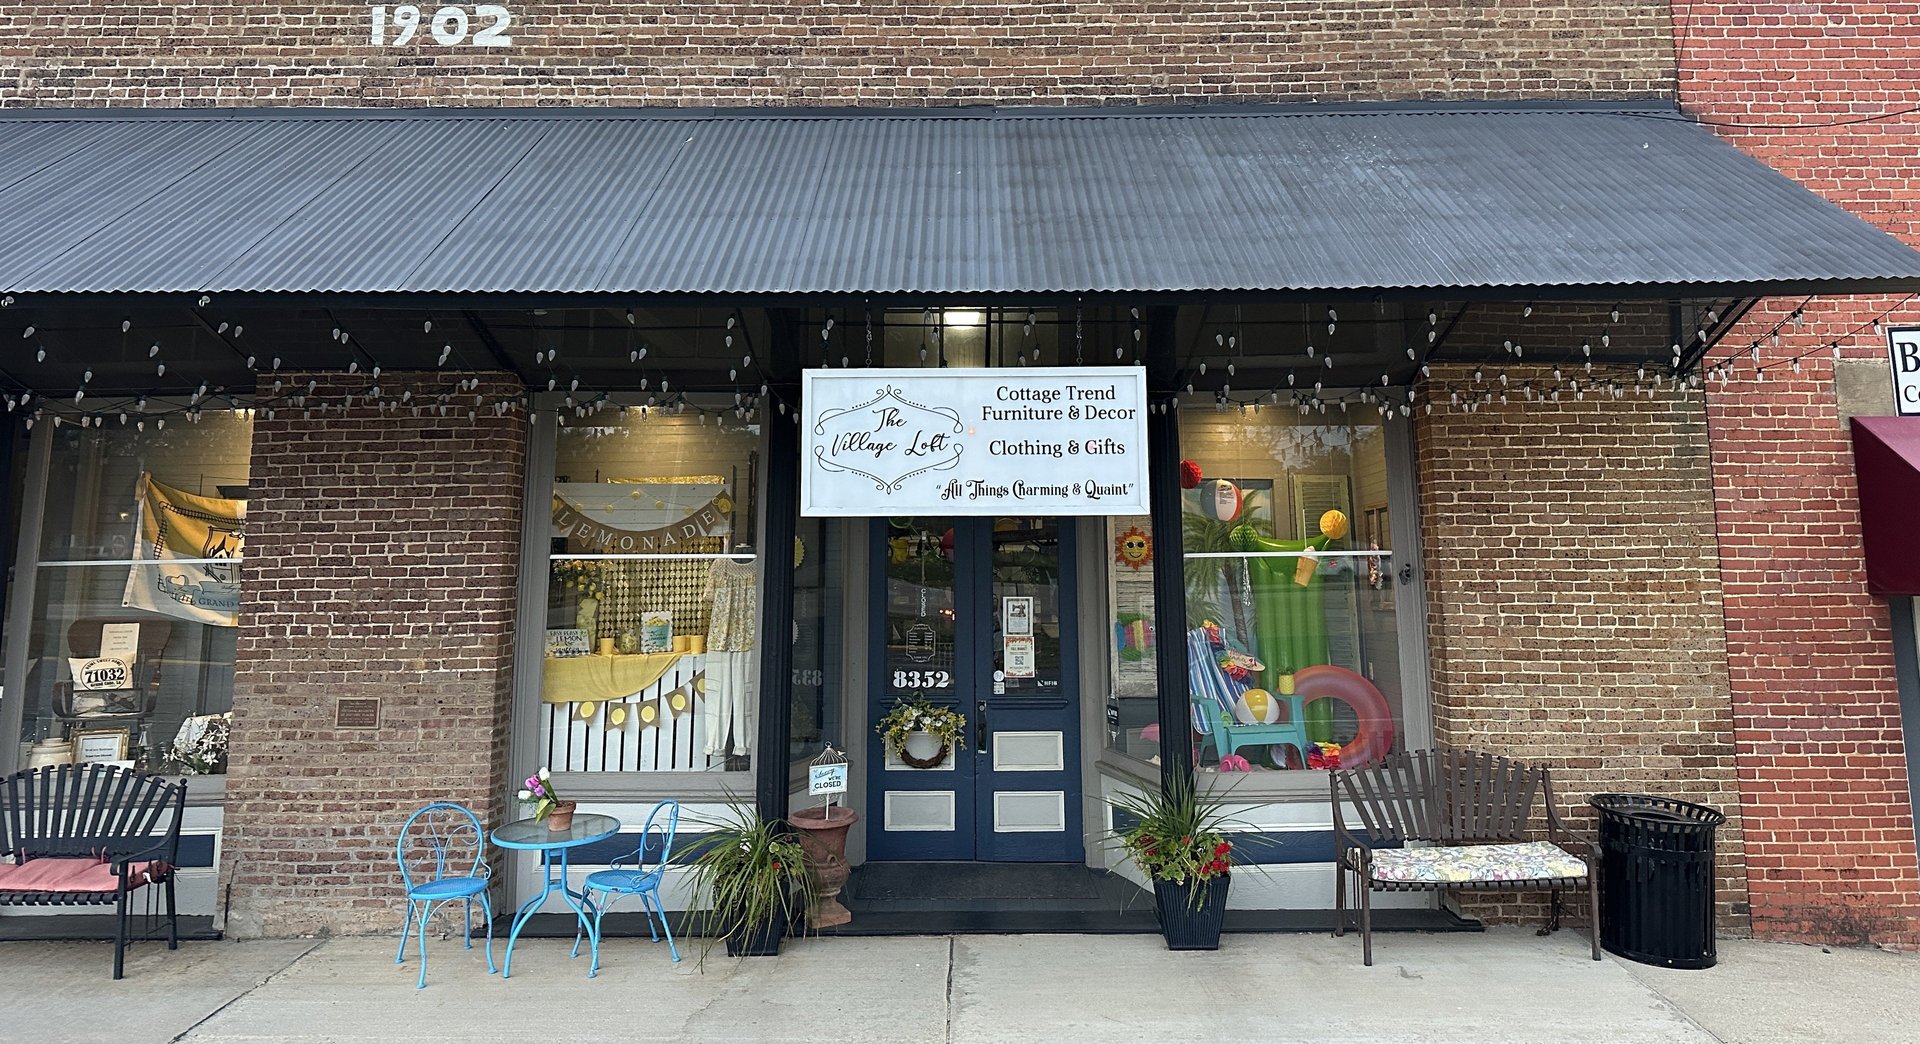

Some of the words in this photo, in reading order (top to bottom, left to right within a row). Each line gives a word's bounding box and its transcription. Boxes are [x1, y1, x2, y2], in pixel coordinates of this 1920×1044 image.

[371, 4, 512, 46] 1902
[996, 386, 1061, 403] Cottage
[1066, 385, 1116, 400] Trend
[1904, 385, 1920, 403] C
[872, 407, 908, 432] The
[982, 405, 1063, 421] Furniture
[1068, 405, 1080, 420] &
[1085, 405, 1136, 420] Decor
[831, 431, 897, 458] Village
[904, 430, 951, 456] Loft
[989, 440, 1063, 458] Clothing
[1068, 440, 1080, 455] &
[1085, 438, 1125, 455] Gifts
[966, 479, 1009, 500] Things
[1012, 480, 1069, 499] Charming
[1072, 483, 1082, 495] &
[557, 510, 716, 550] LEMONADE
[198, 597, 235, 608] GRAND
[85, 668, 125, 684] 71032
[893, 670, 950, 688] 8352
[814, 780, 842, 789] CLOSED
